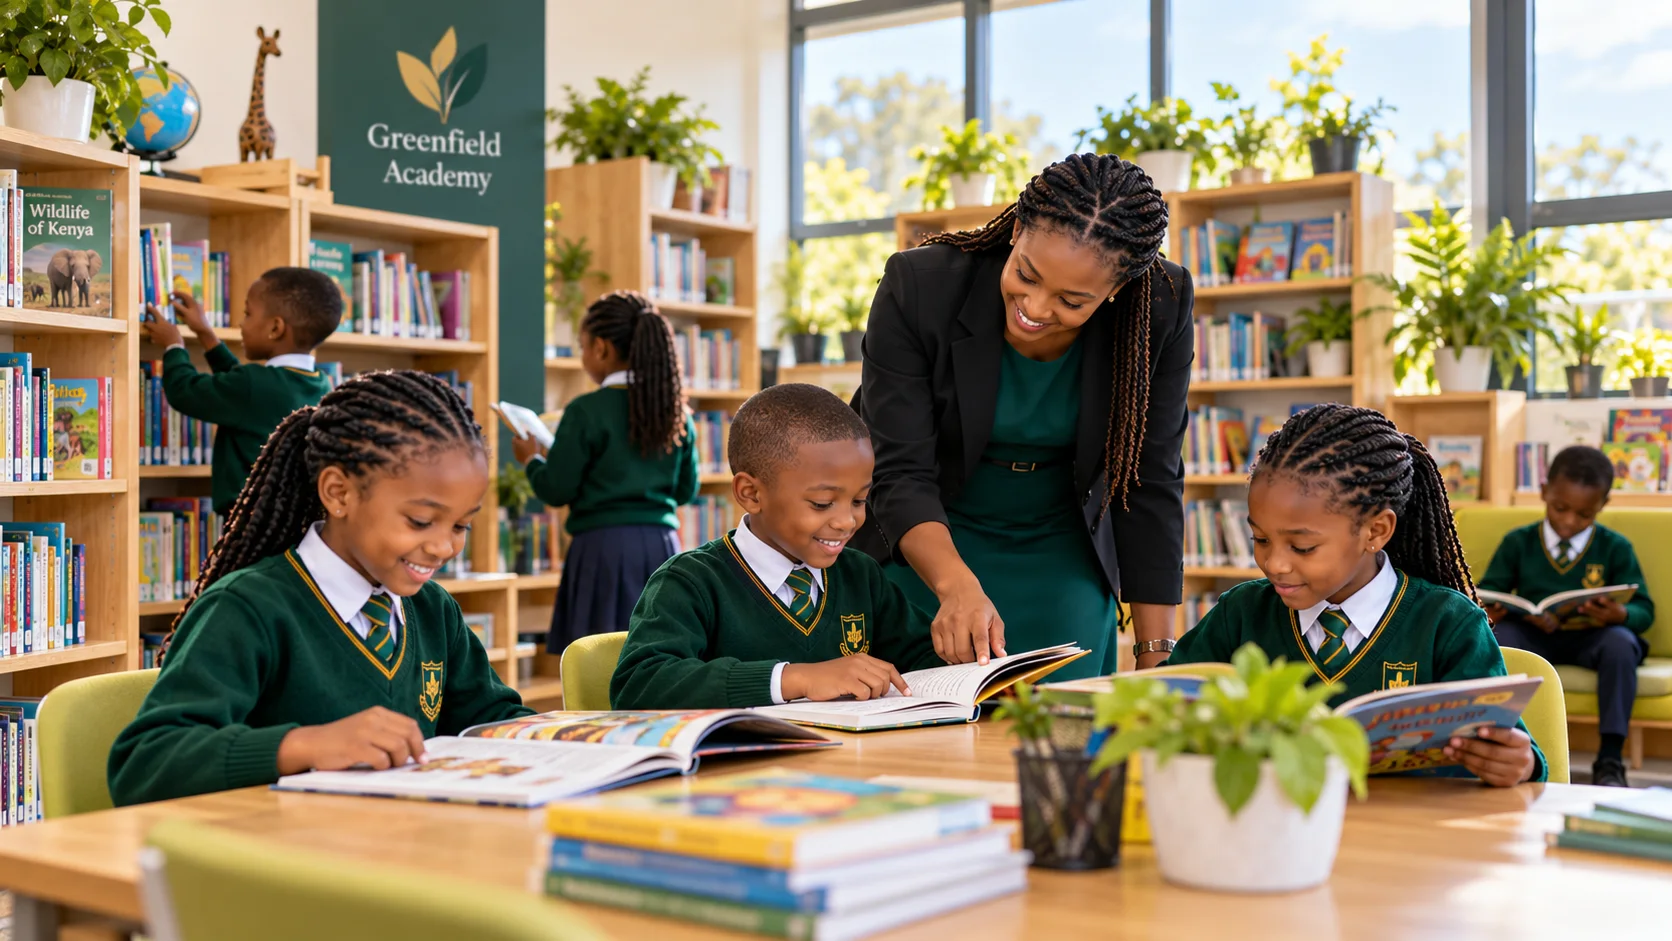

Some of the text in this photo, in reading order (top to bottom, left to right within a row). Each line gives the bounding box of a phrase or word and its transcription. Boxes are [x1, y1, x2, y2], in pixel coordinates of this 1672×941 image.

[367, 123, 502, 157] Greenfield
[383, 159, 492, 196] Academy
[29, 203, 90, 219] Wildlife
[27, 220, 94, 239] of Kenya
